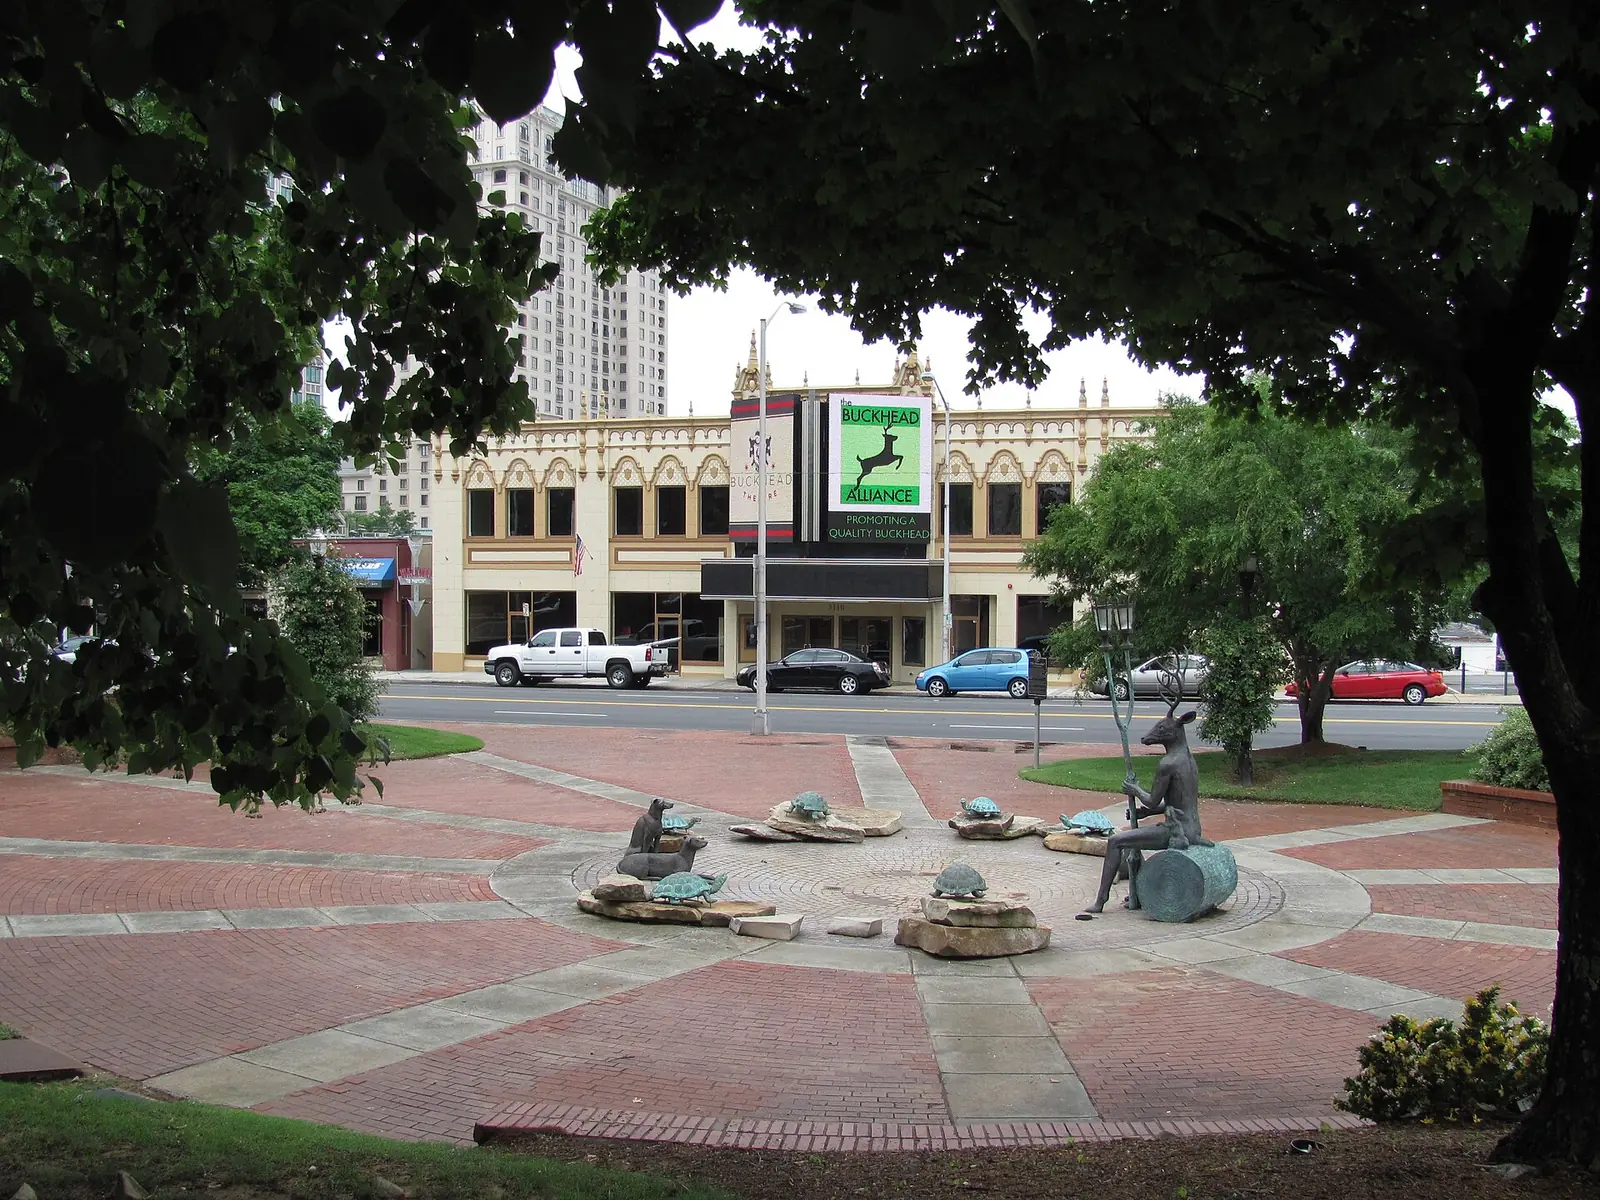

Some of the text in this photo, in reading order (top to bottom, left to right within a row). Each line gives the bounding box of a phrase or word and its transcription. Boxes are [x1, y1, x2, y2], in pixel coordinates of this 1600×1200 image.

[841, 397, 852, 407] the
[842, 408, 920, 424] BUCKHEAD
[743, 490, 777, 502] THERE
[846, 489, 912, 503] ALLIANCE
[846, 515, 916, 525] PROMOTING A
[829, 528, 930, 539] QUALITY BUCKHEAD
